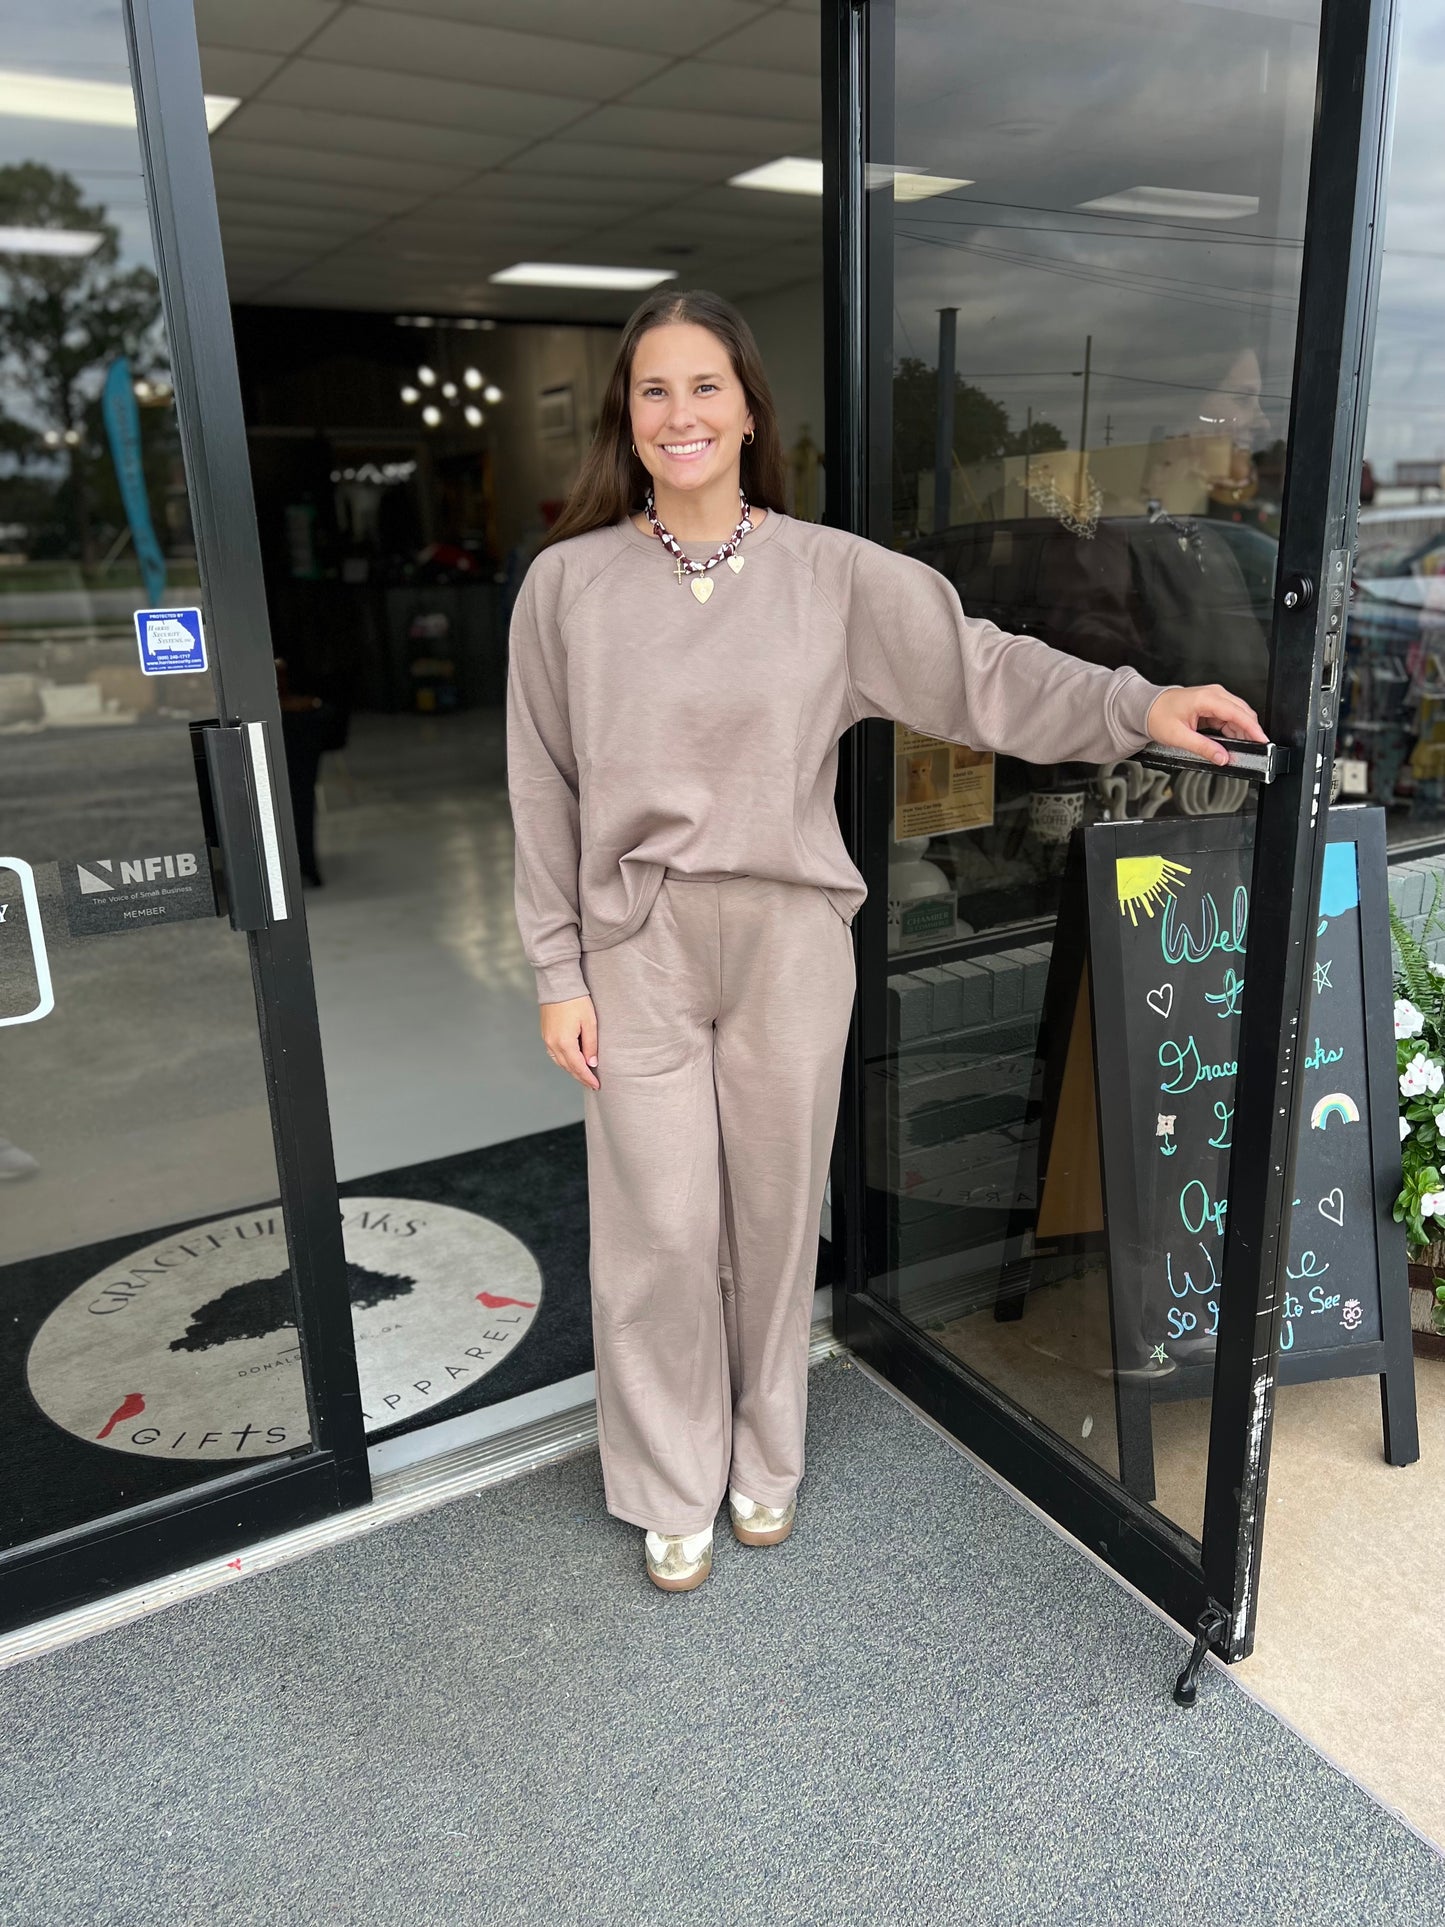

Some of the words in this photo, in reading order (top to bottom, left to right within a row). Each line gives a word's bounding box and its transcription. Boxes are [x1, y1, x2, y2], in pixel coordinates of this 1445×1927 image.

[120, 853, 198, 884] NFIB
[108, 895, 129, 903] Voice
[140, 889, 160, 898] Small
[161, 886, 192, 895] Business
[123, 906, 166, 919] MEMBER
[1161, 885, 1247, 965] Wel
[1158, 1035, 1238, 1094] Grace
[1304, 1037, 1344, 1069] aks
[342, 1211, 427, 1237] AKS
[1282, 1291, 1304, 1319] to
[1308, 1286, 1341, 1315] See
[131, 1423, 286, 1452] GIFTS
